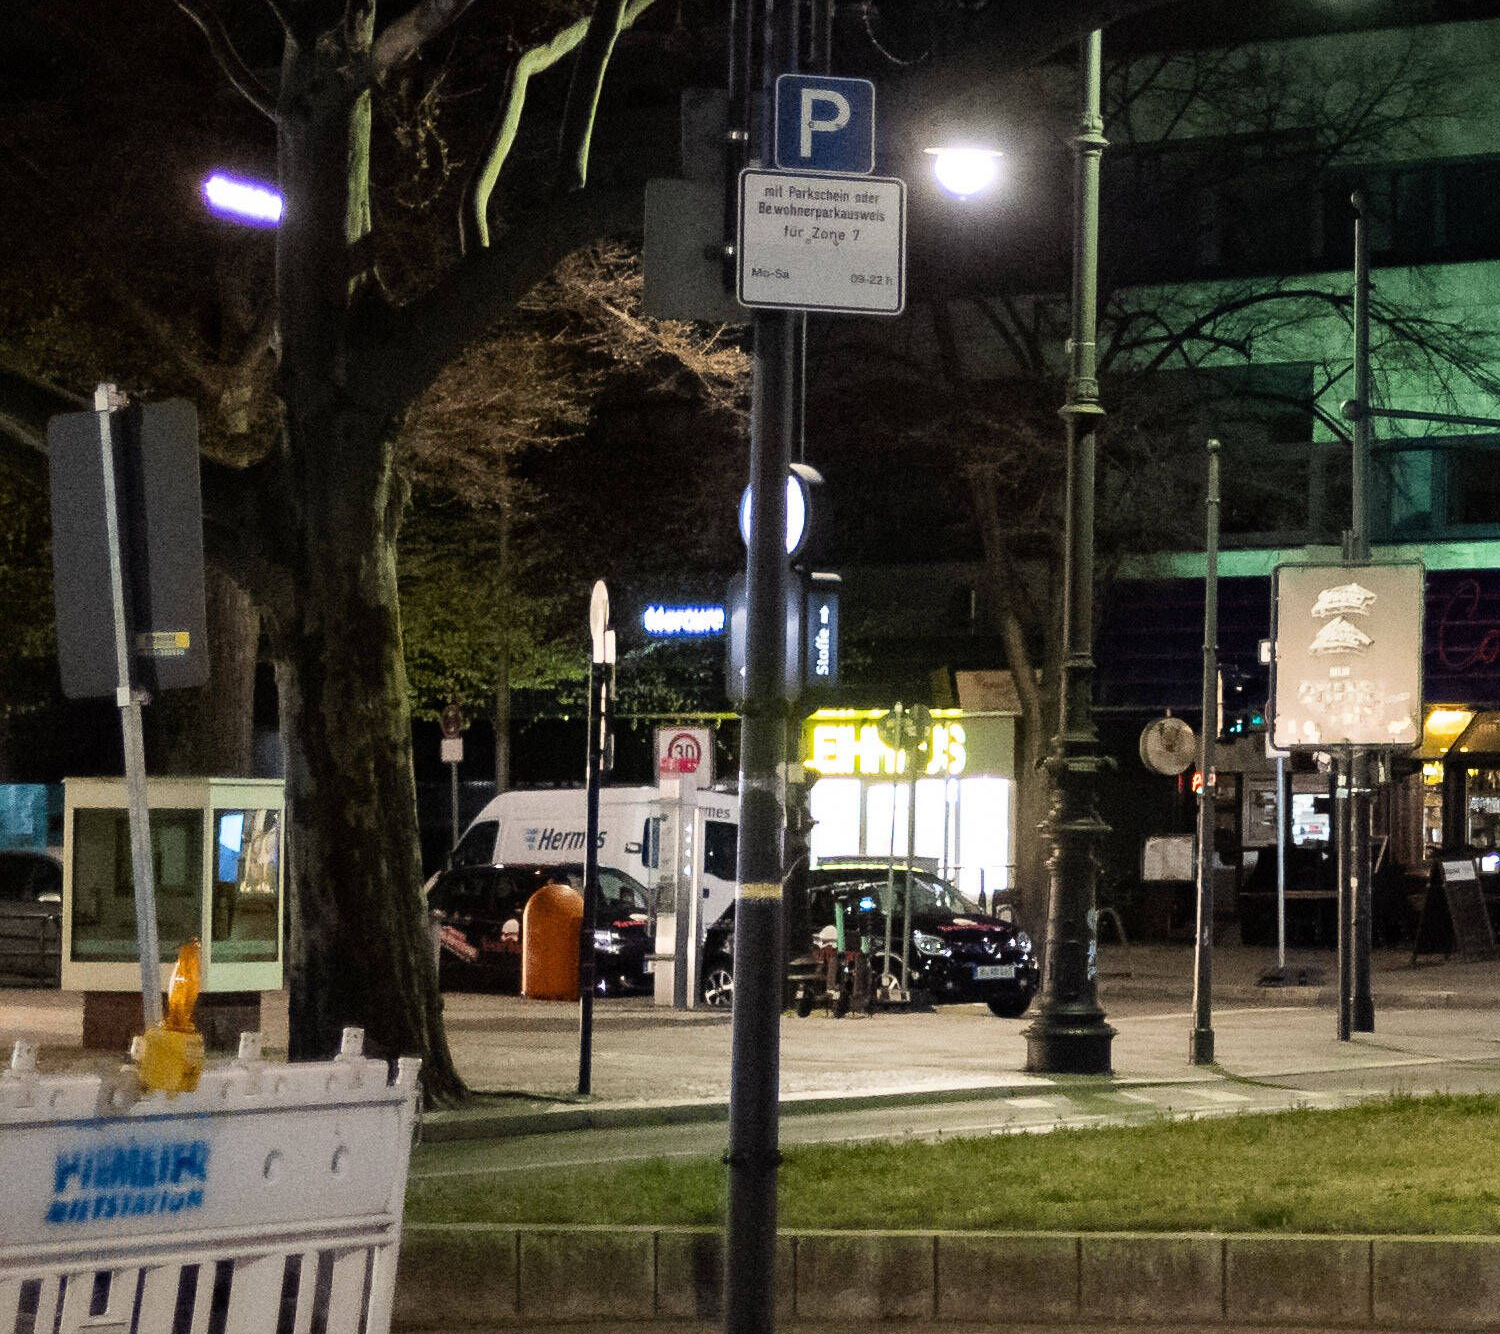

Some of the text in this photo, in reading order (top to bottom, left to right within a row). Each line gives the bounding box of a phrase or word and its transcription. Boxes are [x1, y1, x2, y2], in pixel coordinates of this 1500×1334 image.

[799, 87, 851, 158] P
[764, 185, 880, 204] mit Parkschein oder
[811, 226, 846, 242] Zone
[538, 827, 607, 851] Herms
